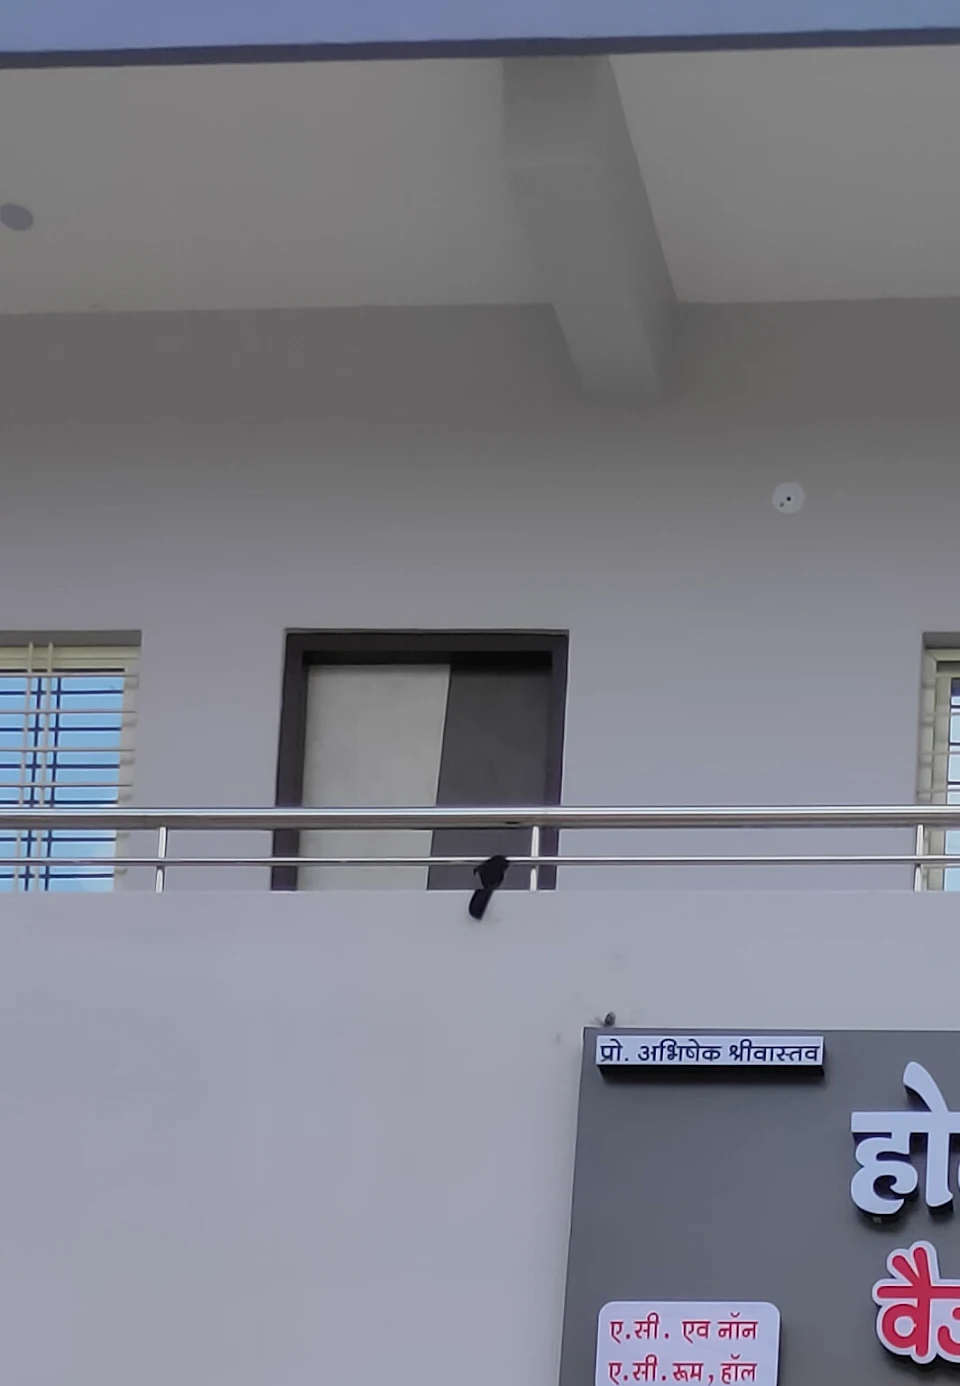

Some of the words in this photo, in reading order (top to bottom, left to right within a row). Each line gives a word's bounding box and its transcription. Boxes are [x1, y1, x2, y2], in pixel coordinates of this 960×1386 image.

[600, 1039, 629, 1062] प्रो.
[637, 1039, 722, 1062] अभिषेक
[729, 1039, 820, 1062] श्रीवास्तव
[717, 1312, 758, 1340] नॉन
